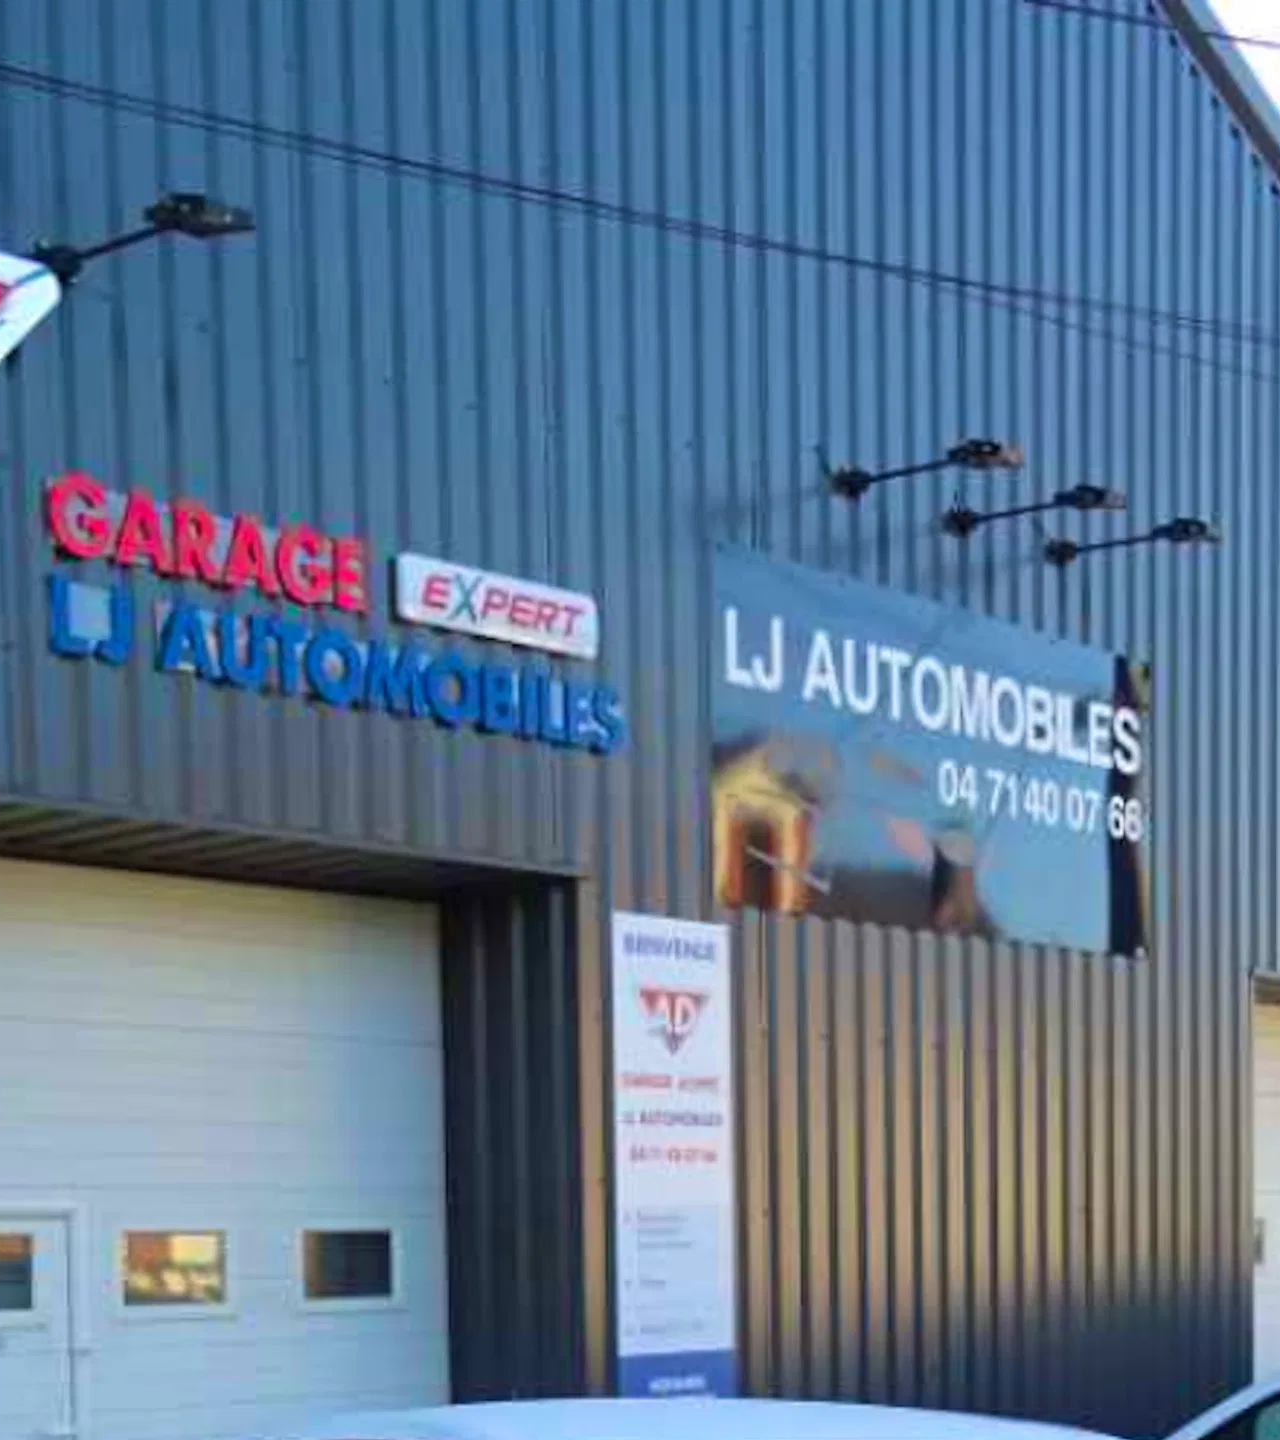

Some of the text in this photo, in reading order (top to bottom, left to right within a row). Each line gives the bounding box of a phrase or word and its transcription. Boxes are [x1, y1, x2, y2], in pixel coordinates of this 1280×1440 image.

[46, 470, 586, 638] GARAGE EXPERT
[45, 572, 628, 755] LJ AUTOMOBILES
[724, 606, 1143, 776] LJ AUTOMOBILES
[937, 759, 978, 812] 04
[985, 768, 1018, 822] 71
[1022, 776, 1061, 828] 40
[1066, 786, 1102, 834] 07
